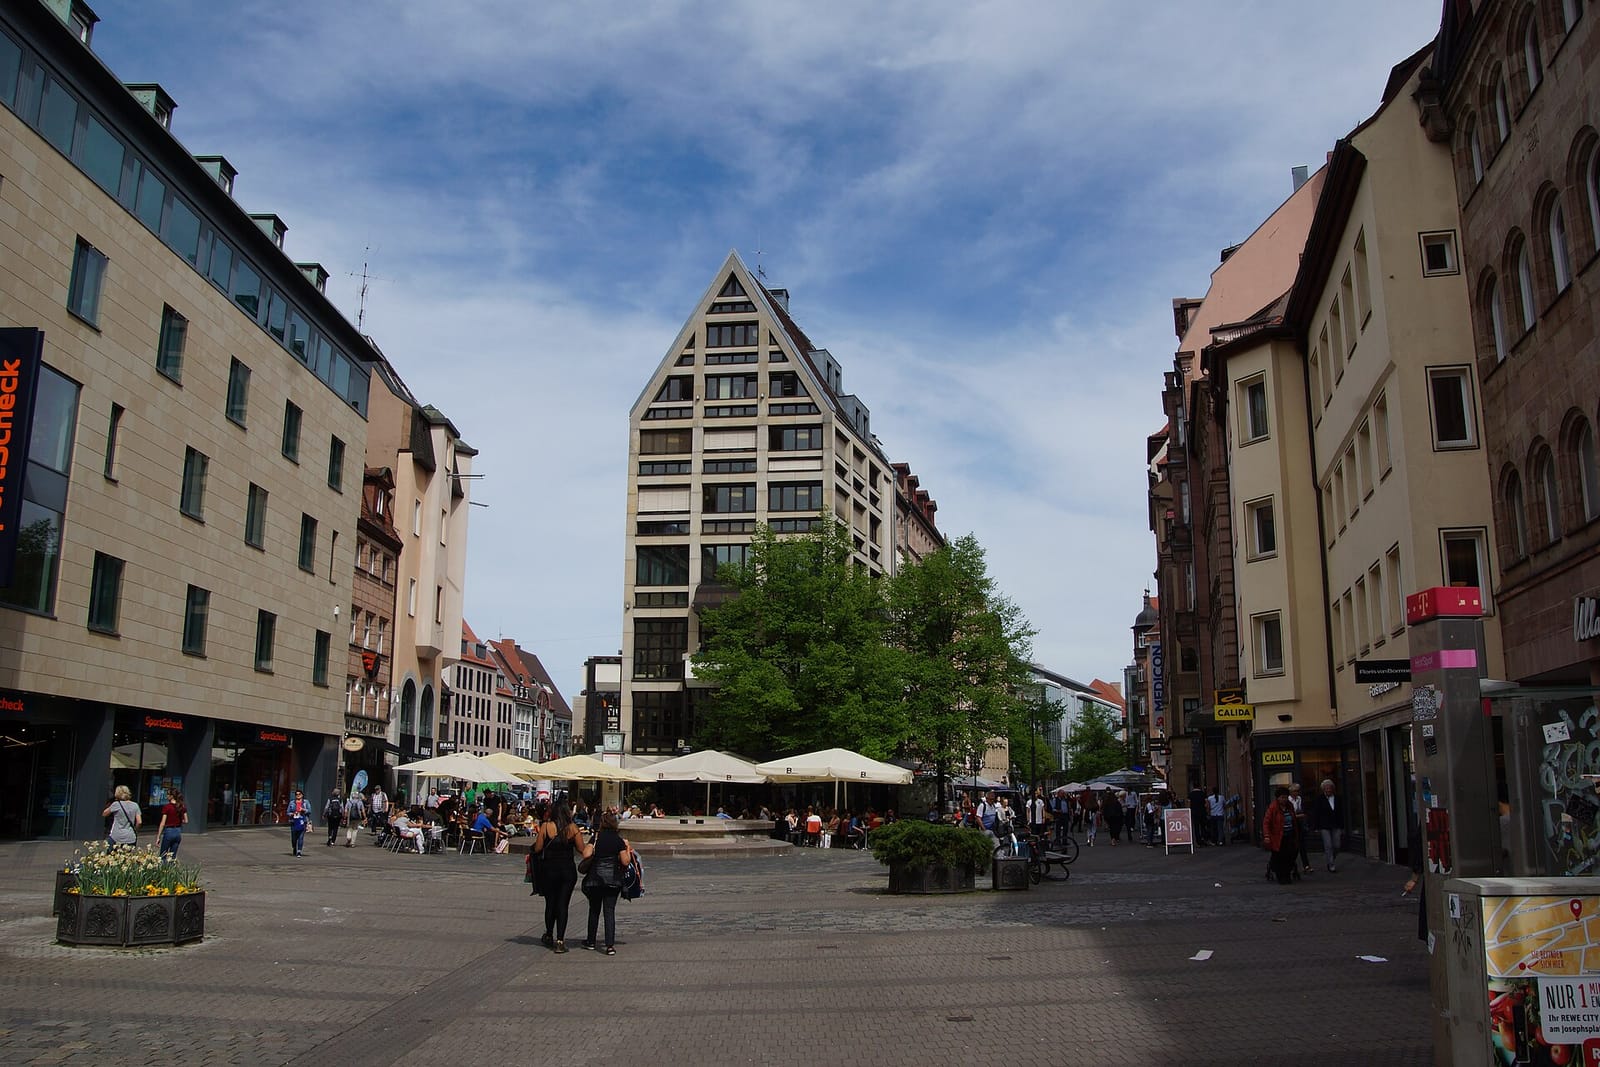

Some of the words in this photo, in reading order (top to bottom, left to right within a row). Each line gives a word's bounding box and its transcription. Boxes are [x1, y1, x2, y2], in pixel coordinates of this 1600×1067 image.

[1152, 645, 1164, 712] MEDICON
[1217, 708, 1251, 717] CALIDA
[144, 715, 184, 730] SportScheck
[260, 730, 288, 742] SportScheck
[1264, 753, 1292, 762] CALIDA
[1546, 984, 1576, 1009] NUR
[1578, 983, 1588, 1008] 1
[1548, 1014, 1559, 1022] Ihr
[1561, 1014, 1581, 1022] REWE
[1582, 1014, 1599, 1022] CITY
